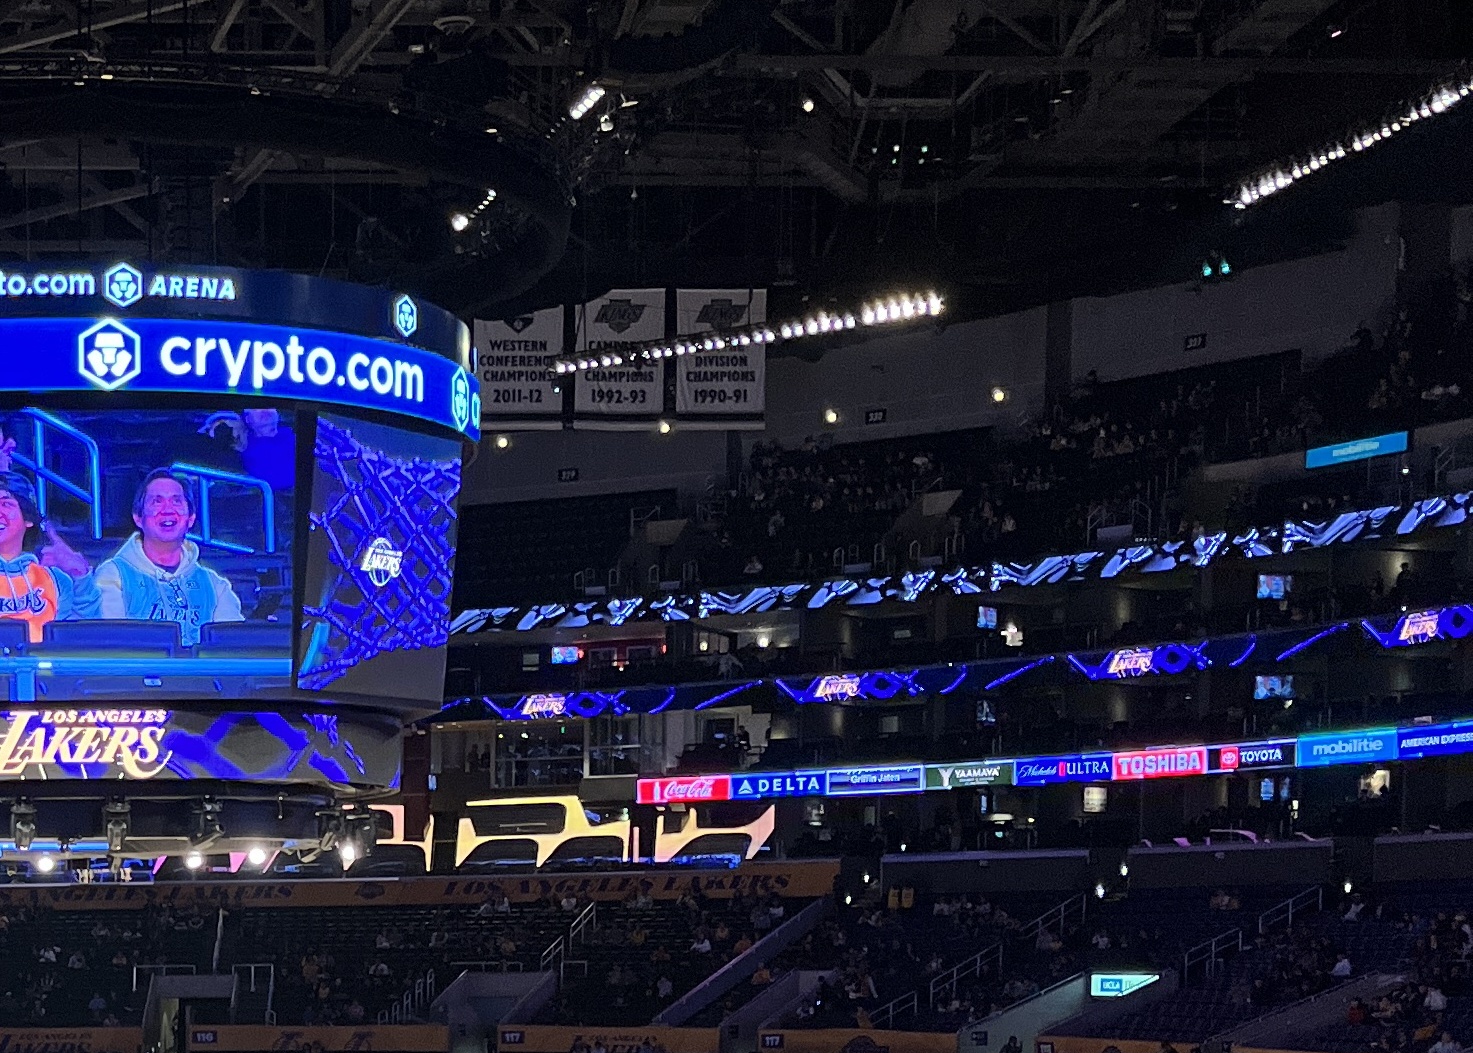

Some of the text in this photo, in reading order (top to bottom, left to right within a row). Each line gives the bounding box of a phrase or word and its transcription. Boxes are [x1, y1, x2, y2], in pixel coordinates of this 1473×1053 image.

[150, 276, 236, 300] ARENA
[490, 340, 547, 351] WESTERN
[160, 334, 425, 402] crypto.com
[695, 355, 748, 367] DIVISION
[483, 370, 556, 382] CHAMPIONS
[585, 371, 654, 383] CHAMPIONS
[686, 370, 755, 382] CHAMPIONS
[493, 389, 543, 403] 2011-12
[592, 389, 647, 404] 1992-93
[694, 389, 748, 403] 1990-91
[42, 709, 167, 723] LOS ANGELES
[1313, 737, 1384, 756] mobilitie
[1400, 735, 1440, 749] AMERICAN
[1240, 748, 1283, 763] TOYOTA
[1067, 761, 1110, 775] ULTRA
[1118, 751, 1201, 775] TOSHIBA
[758, 777, 820, 792] DELTA
